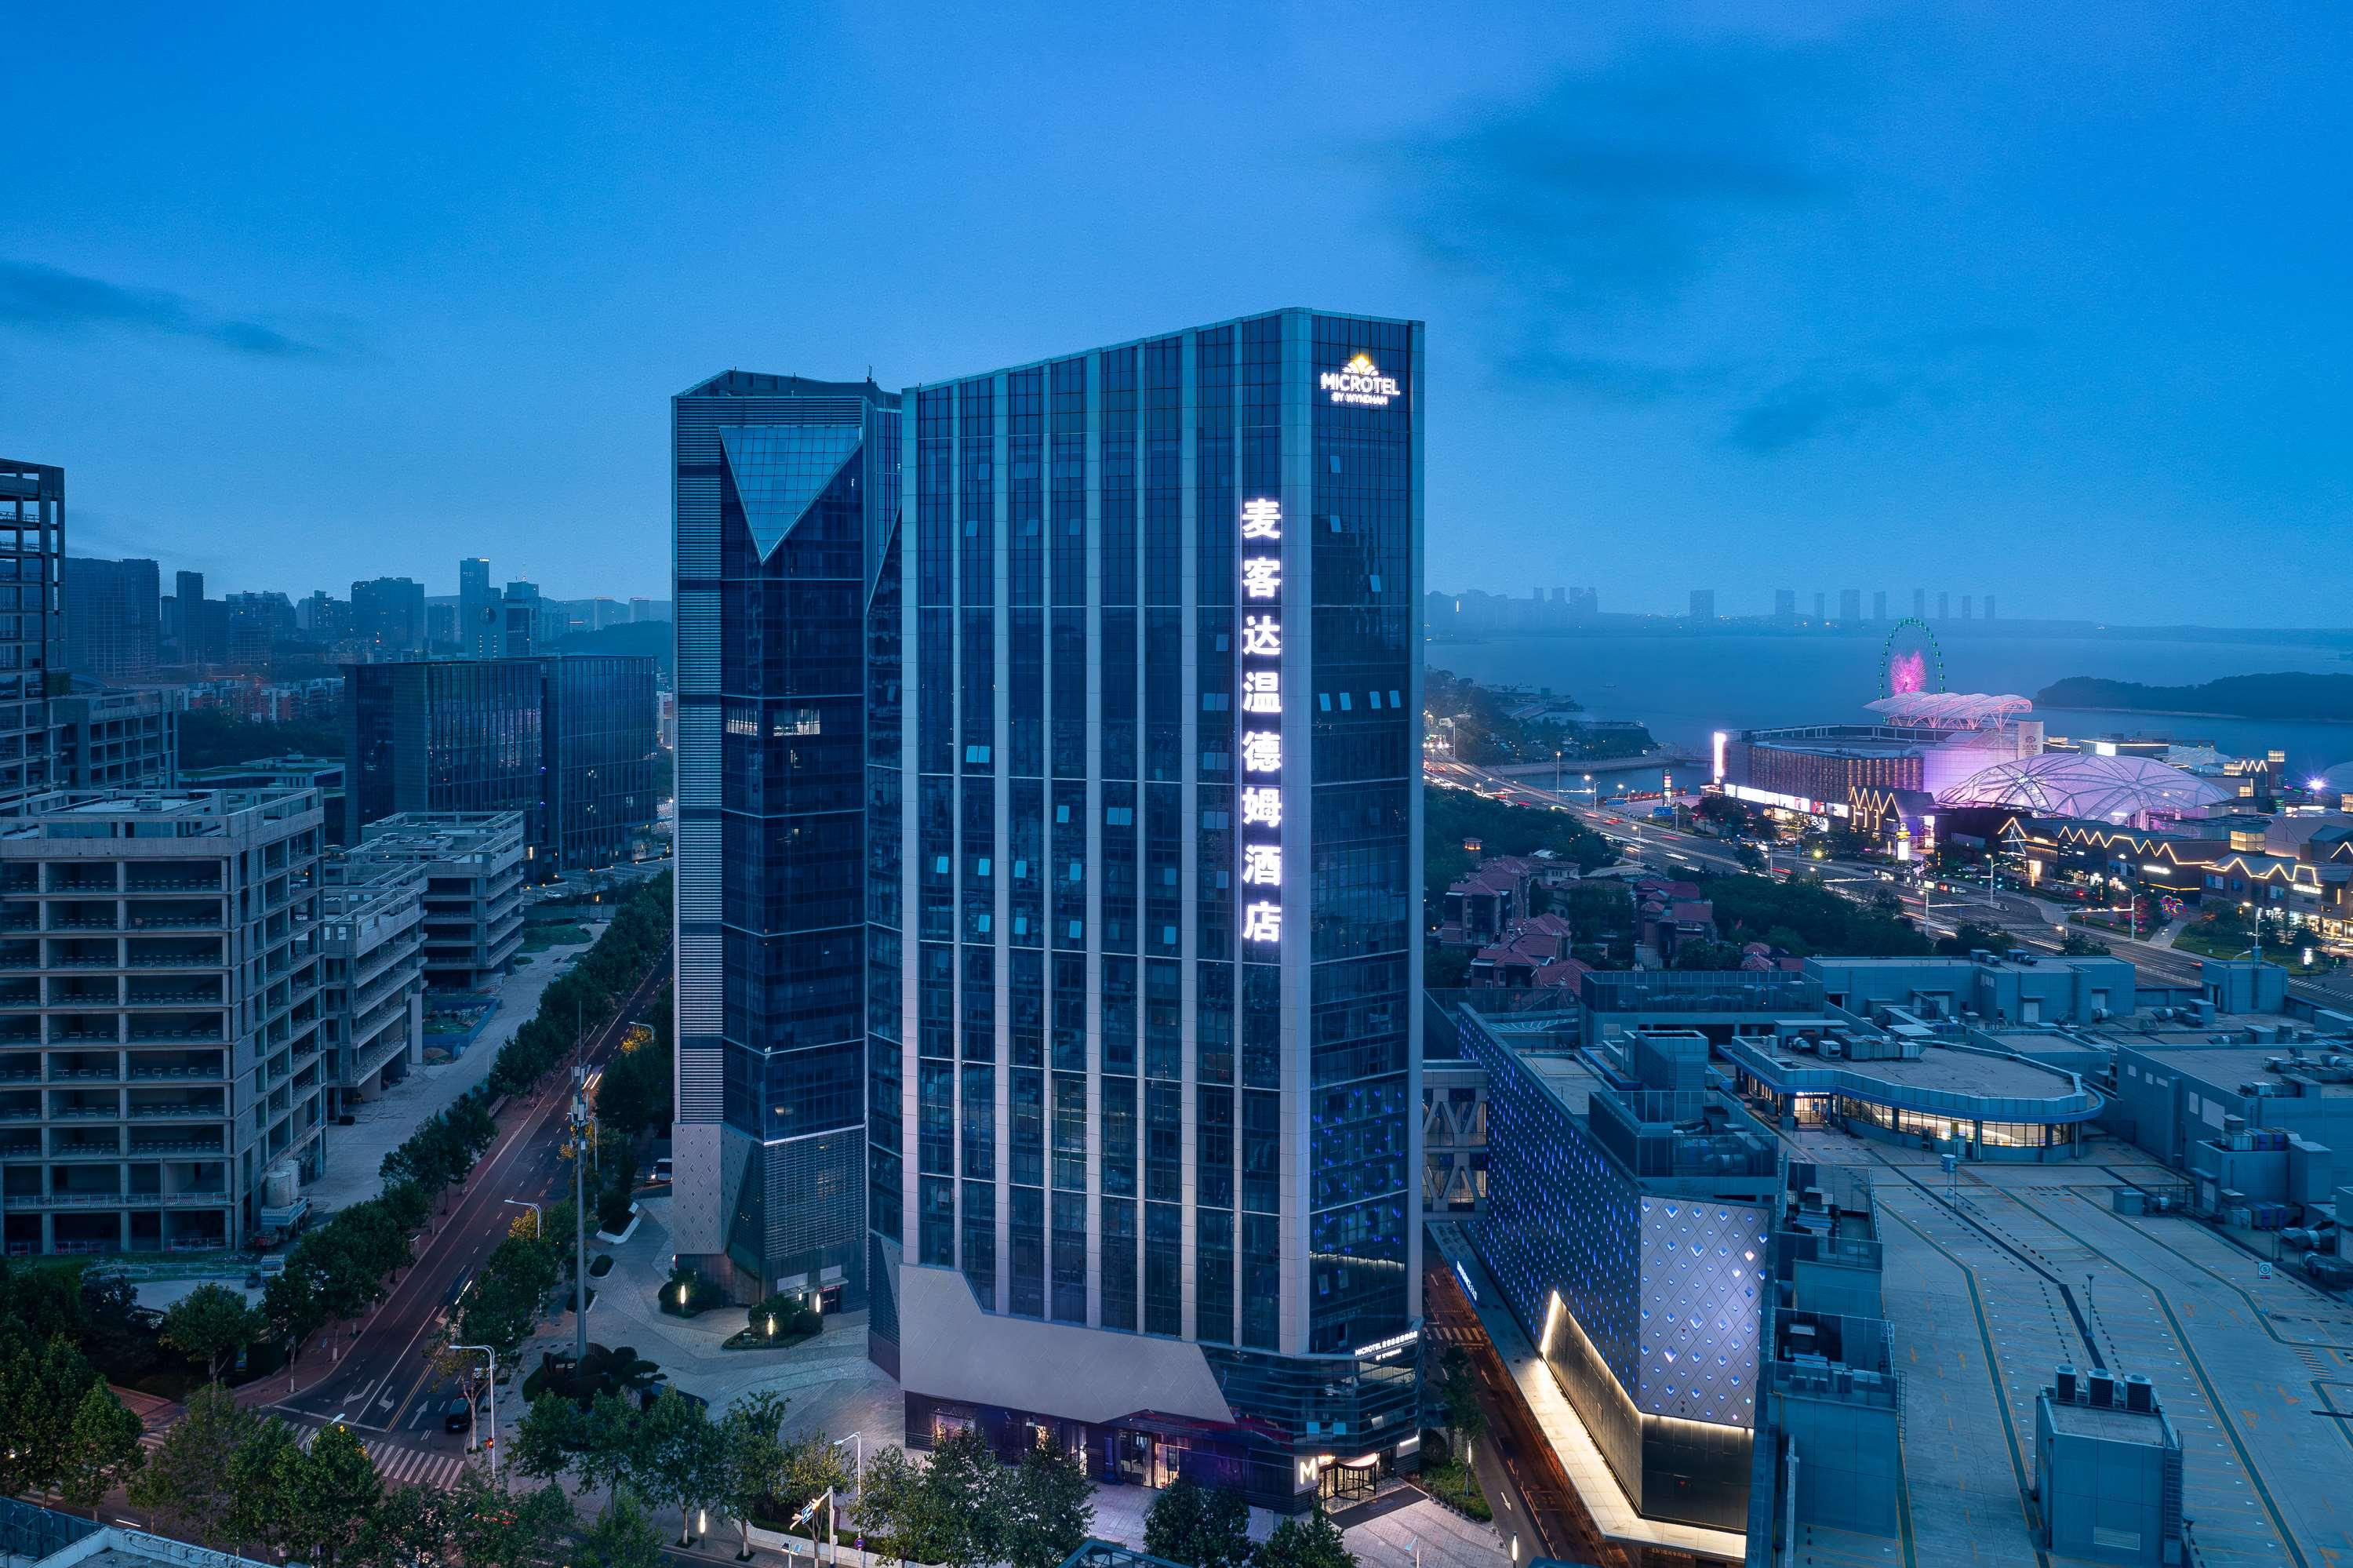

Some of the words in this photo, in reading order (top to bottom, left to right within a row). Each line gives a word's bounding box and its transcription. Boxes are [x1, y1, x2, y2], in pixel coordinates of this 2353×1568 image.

[1320, 372, 1401, 395] MICROTEL
[1331, 391, 1344, 402] BY
[1345, 393, 1387, 406] WYNDHAM
[1242, 498, 1282, 943] 麦客达温德姆酒店
[1300, 1457, 1316, 1485] M
